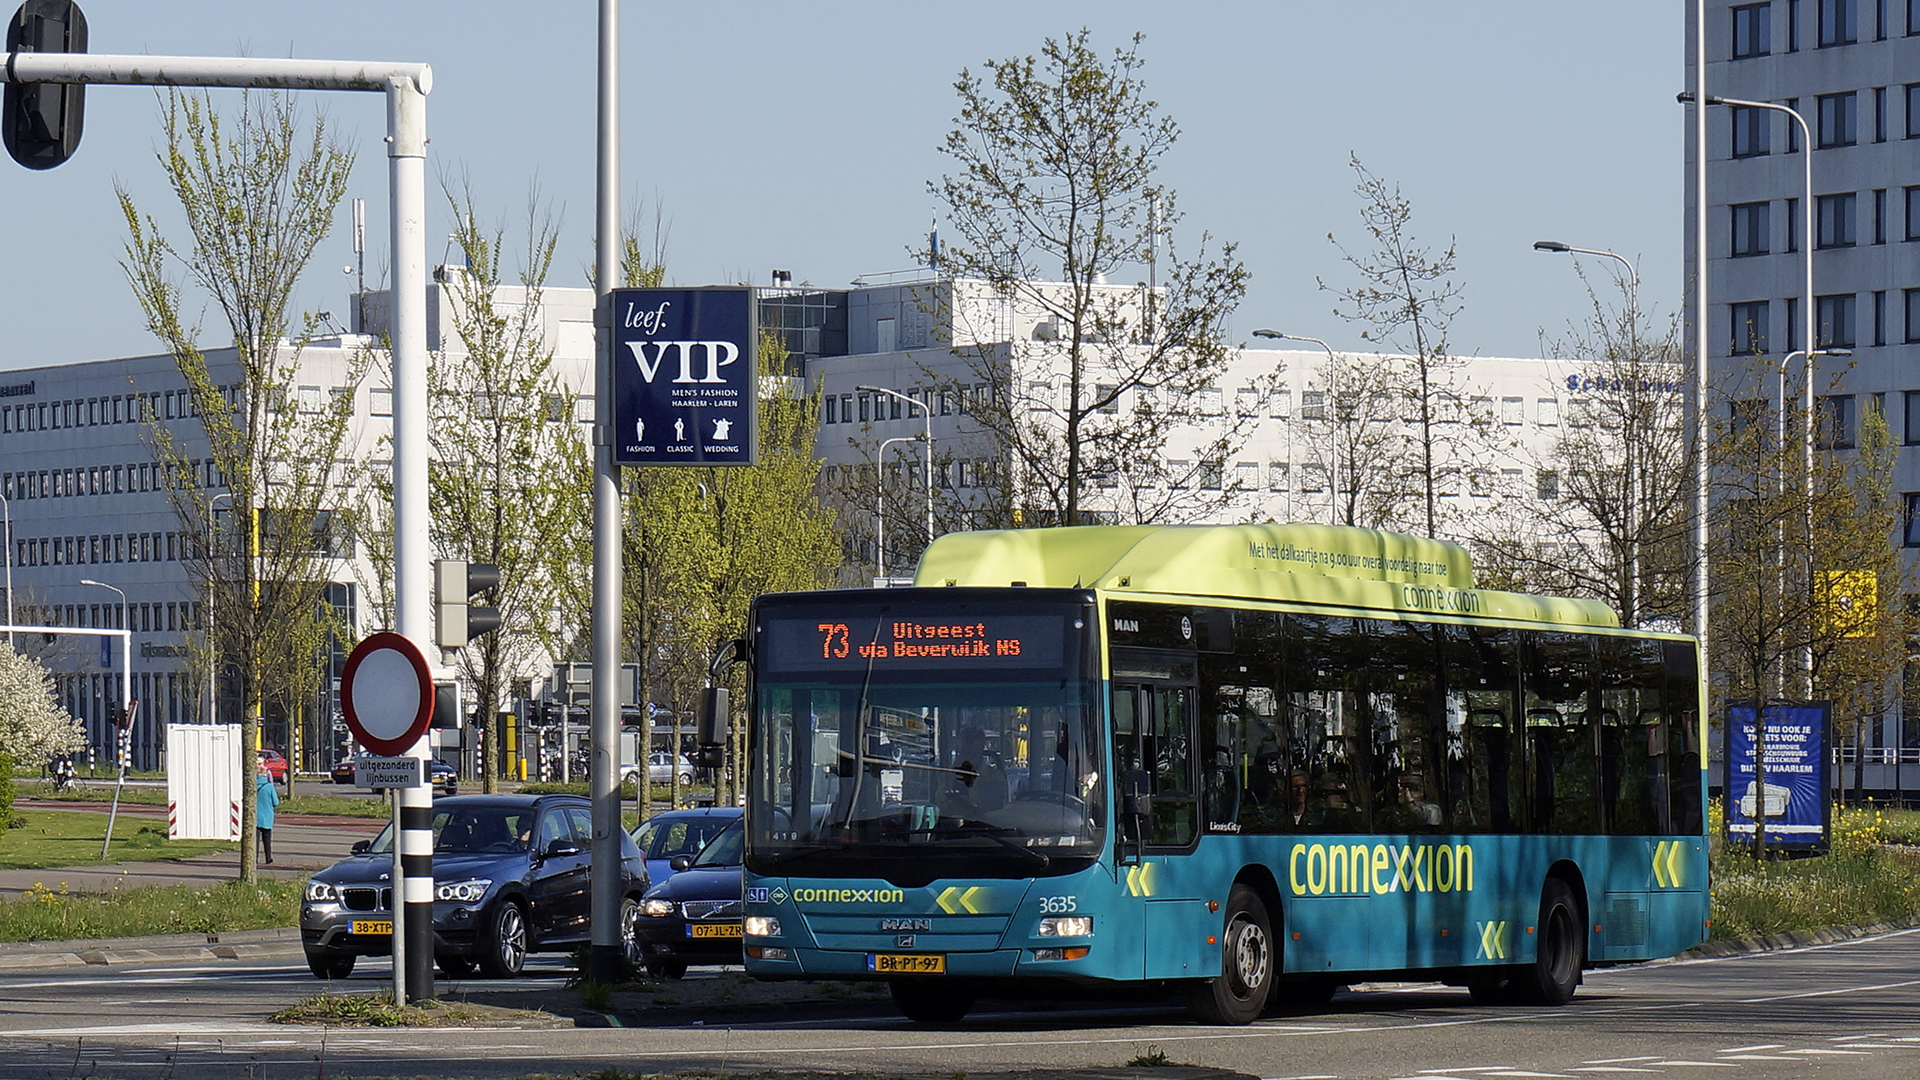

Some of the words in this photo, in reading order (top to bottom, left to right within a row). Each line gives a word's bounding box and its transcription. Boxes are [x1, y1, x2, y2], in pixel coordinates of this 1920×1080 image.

[624, 302, 671, 336] leef.
[624, 341, 739, 384] VIP
[671, 389, 698, 397] MEN'S
[700, 389, 738, 397] FASHION
[626, 445, 656, 453] FASHION
[666, 445, 694, 453] CLASSIC
[704, 445, 739, 453] WEDDING
[1249, 541, 1265, 559] Met
[1266, 541, 1280, 560] het
[1280, 543, 1318, 569] dalkaartje
[1319, 551, 1329, 564] na
[1329, 552, 1348, 569] 9.00
[1349, 554, 1361, 568] uur
[1361, 553, 1384, 570] overal
[1384, 555, 1418, 578] voordelig
[1419, 560, 1434, 575] naar
[1435, 560, 1447, 576] toe
[1403, 586, 1480, 613] connexxion
[893, 622, 985, 638] Uitgeest
[1114, 618, 1139, 632] MAN
[818, 623, 850, 658] 73
[858, 641, 889, 658] via
[893, 640, 991, 657] Beverwijk
[996, 639, 1021, 656] NS
[1743, 725, 1767, 733] KO
[1782, 726, 1800, 734] OOK
[1801, 726, 1811, 734] JE
[1747, 734, 1780, 742] TIETS
[360, 760, 415, 772] uitgezonderd
[1773, 765, 1813, 773] HAARLEM
[366, 773, 409, 786] lijnbussen
[1289, 844, 1473, 895] connexxion
[793, 888, 904, 903] connexxion
[1039, 895, 1077, 914] 3635
[881, 919, 931, 930] MAN
[881, 957, 940, 970] BR-PT-97
